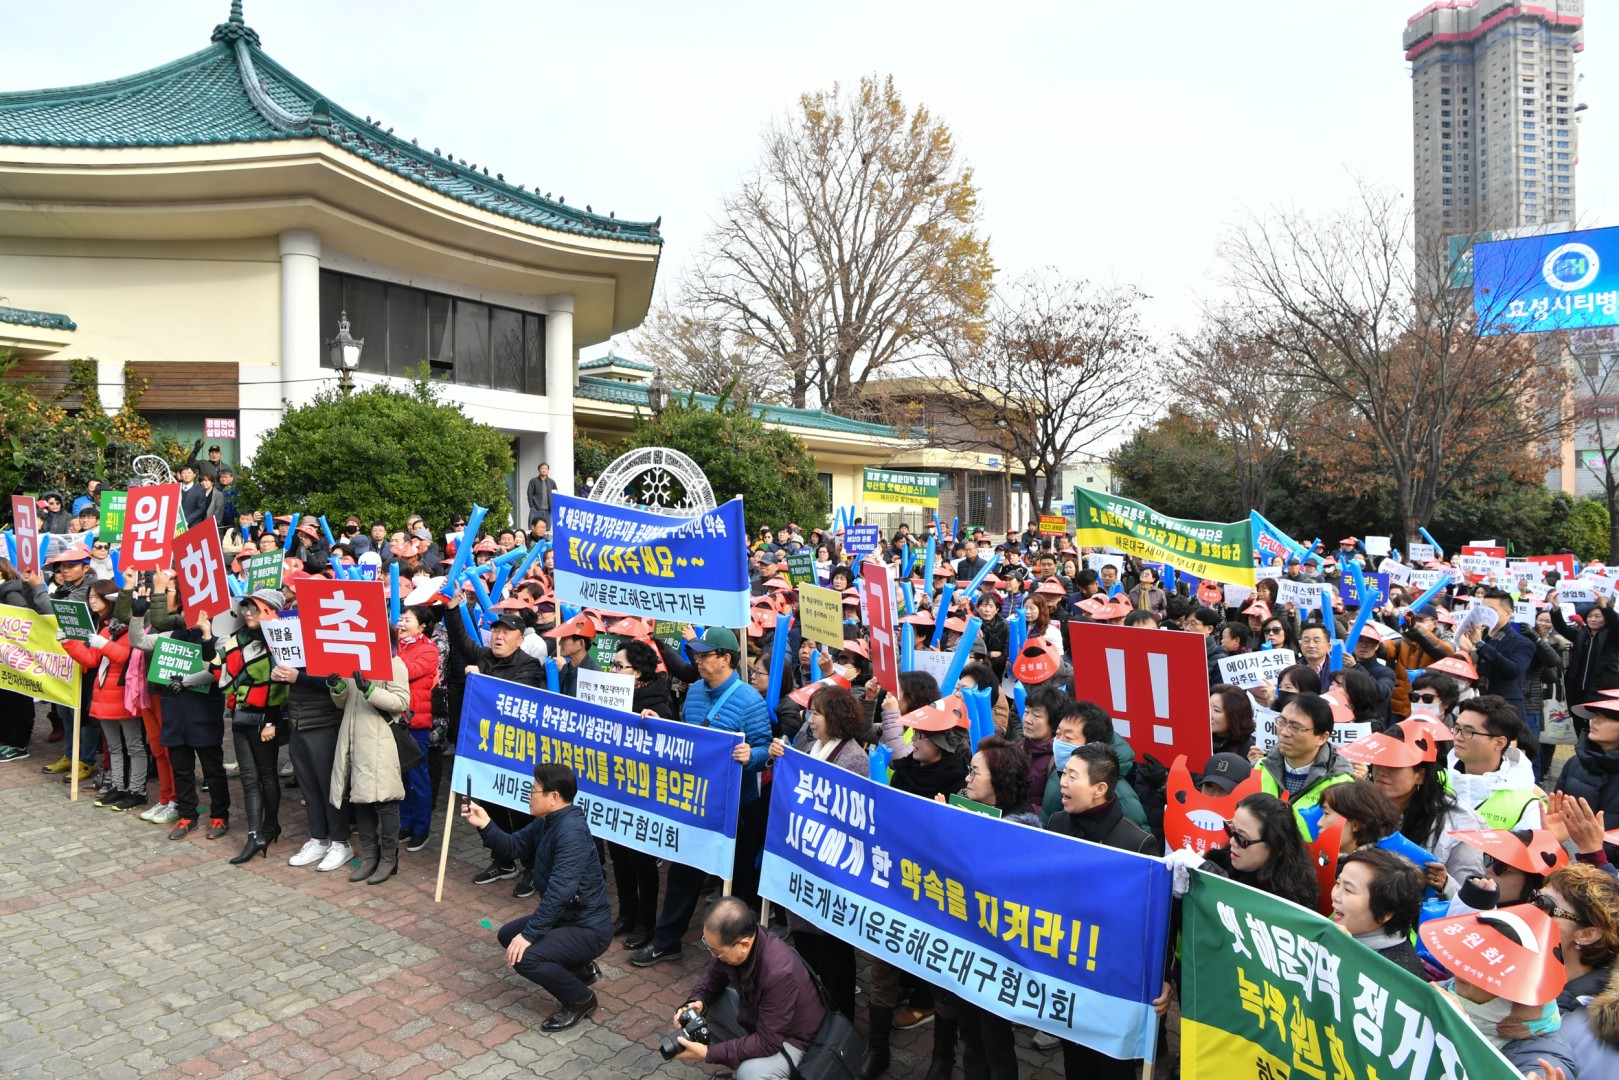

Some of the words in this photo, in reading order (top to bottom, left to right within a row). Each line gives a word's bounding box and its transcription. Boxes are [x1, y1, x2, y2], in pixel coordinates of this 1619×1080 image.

[1506, 291, 1617, 320] 효성시티병
[17, 505, 34, 565] 공
[131, 496, 169, 561] 원
[565, 508, 595, 533] 해운대역
[593, 515, 638, 543] 정거장부지를
[703, 514, 727, 538] 약속
[568, 537, 595, 571] 꼭!!
[1115, 536, 1207, 574] 해운대구새마을부녀회
[180, 538, 219, 607] 화
[580, 580, 706, 616] 새마을문고해운대구지부
[161, 642, 200, 658] 뭐라카노?
[318, 588, 377, 671] 촉
[870, 582, 891, 671] 구
[158, 655, 192, 671] 상업개발
[1020, 662, 1048, 672] 공원화!
[1230, 672, 1258, 685] 입주민
[496, 694, 539, 727] 국토교통부,
[541, 704, 622, 747] 한국철도시설공단에
[623, 725, 653, 755] 보내는
[655, 733, 695, 766] 메시지!!
[478, 718, 491, 752] 옛
[493, 721, 537, 765] 해운대역
[540, 735, 609, 786] 정거장부지를
[613, 755, 650, 799] 주민의
[655, 766, 709, 817] 품으로!!
[793, 769, 875, 835] 부산시여!
[785, 812, 865, 877] 시민에게
[871, 845, 892, 888] 한
[901, 858, 968, 922] 약속을
[975, 890, 1100, 972] 지켜라!!
[788, 871, 1077, 1028] 바르게살기운동해운대구협의회
[1217, 901, 1253, 960] 옛
[1246, 912, 1341, 1022] 해운대역
[1443, 923, 1516, 977] 공원화!
